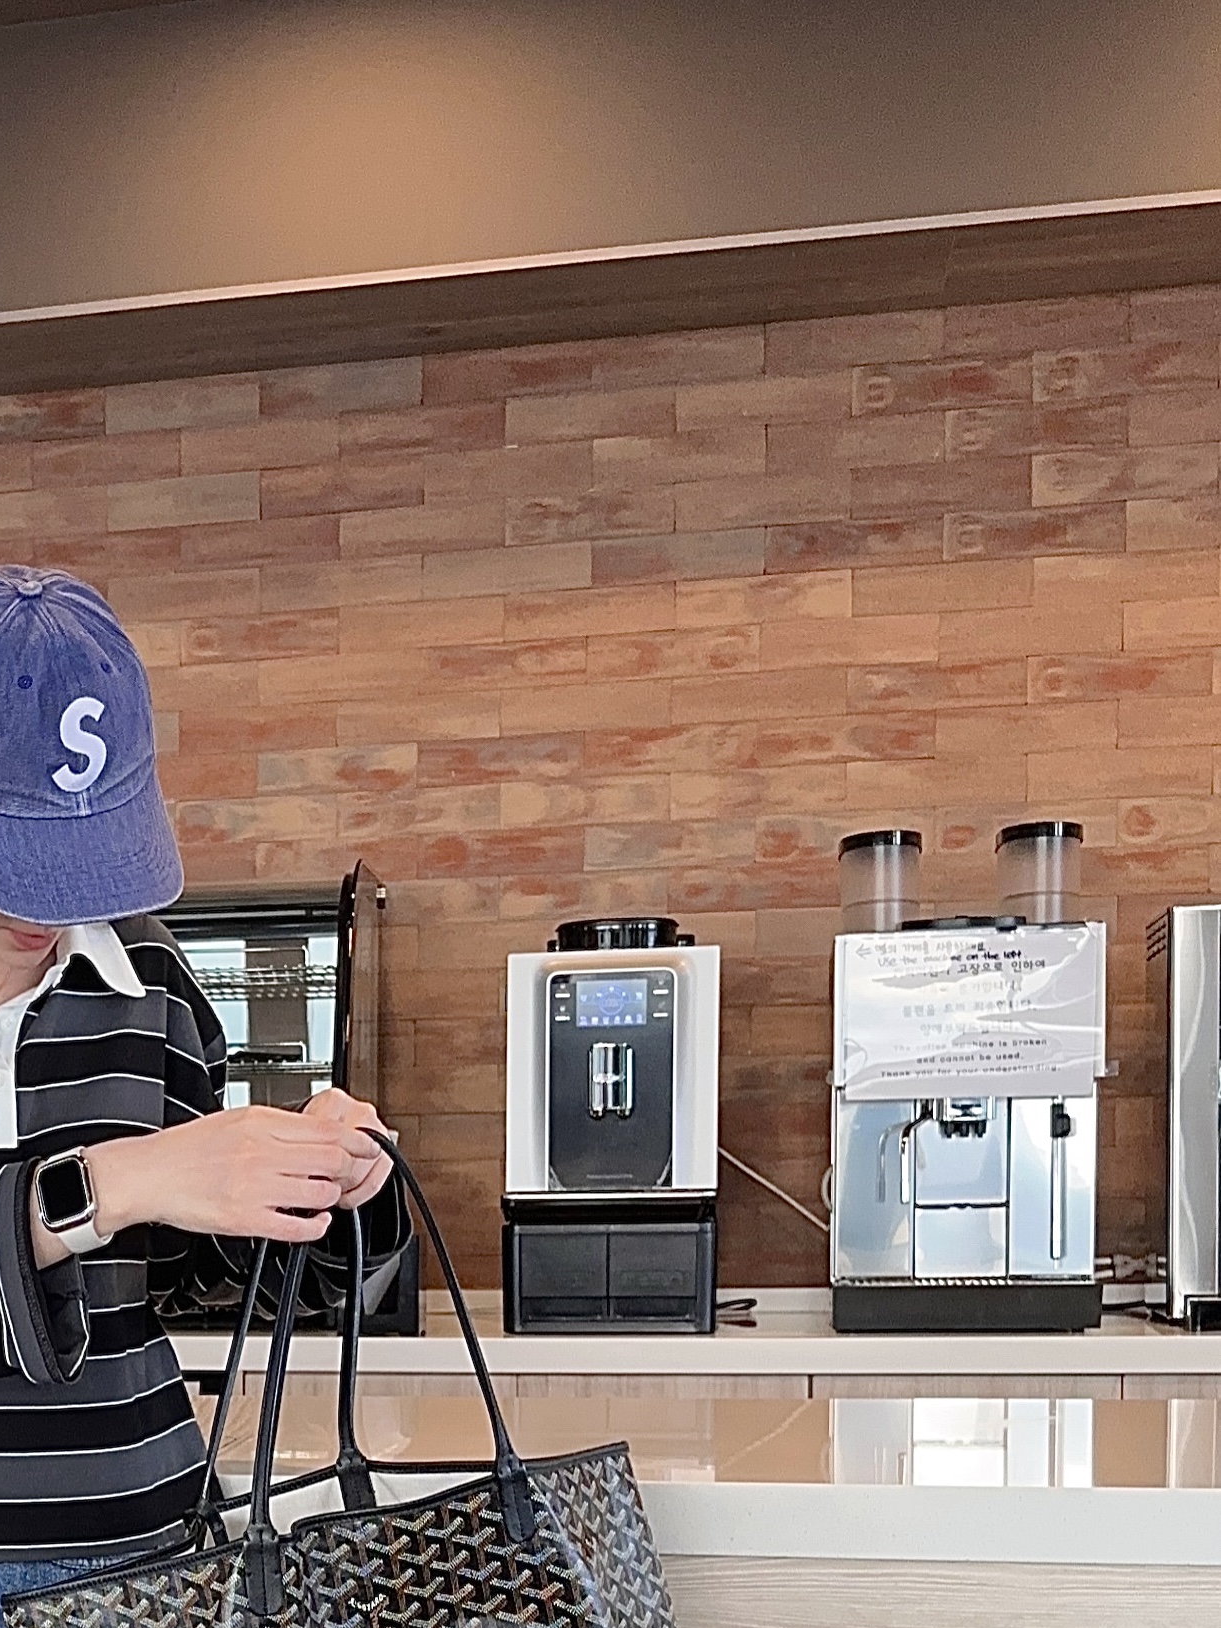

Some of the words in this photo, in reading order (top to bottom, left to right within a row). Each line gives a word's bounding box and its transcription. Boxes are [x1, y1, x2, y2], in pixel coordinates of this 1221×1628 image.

[51, 696, 107, 793] S
[966, 953, 979, 961] on
[982, 951, 1001, 960] the
[957, 961, 1003, 976] 고장으로
[1011, 959, 1046, 973] 인하여
[1012, 1038, 1047, 1047] broken
[916, 1056, 935, 1064] and
[940, 1054, 975, 1063] cannot
[979, 1053, 992, 1061] be
[881, 1070, 911, 1078] Thank
[915, 1069, 933, 1079] you
[956, 1067, 978, 1077] your
